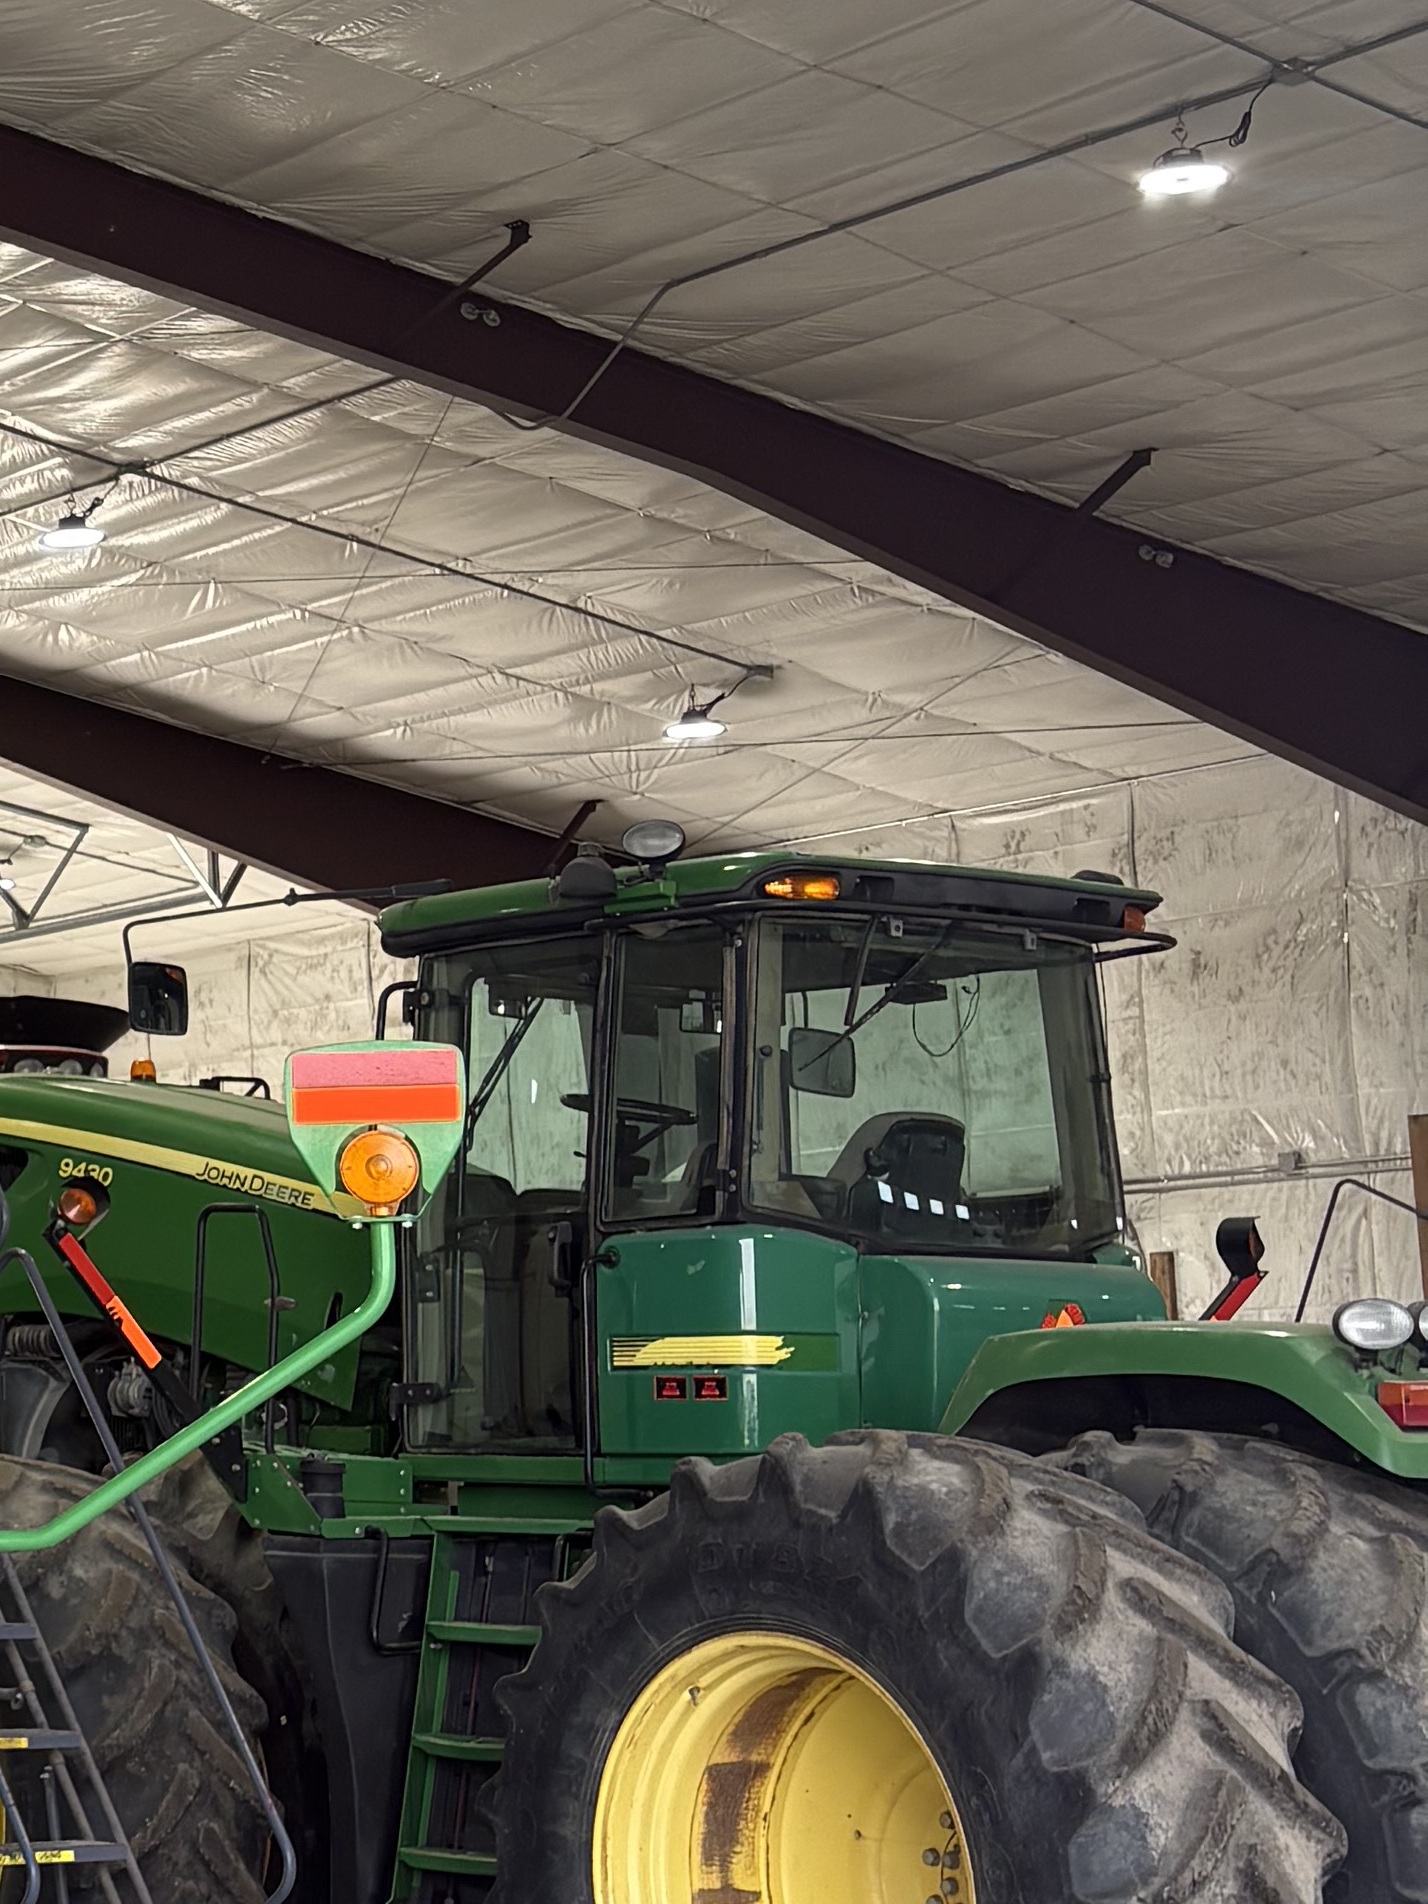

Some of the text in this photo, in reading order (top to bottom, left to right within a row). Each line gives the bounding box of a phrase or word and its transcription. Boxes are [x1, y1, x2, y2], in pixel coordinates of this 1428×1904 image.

[58, 1157, 114, 1187] 9430
[195, 1161, 316, 1208] JOHN DEERE
